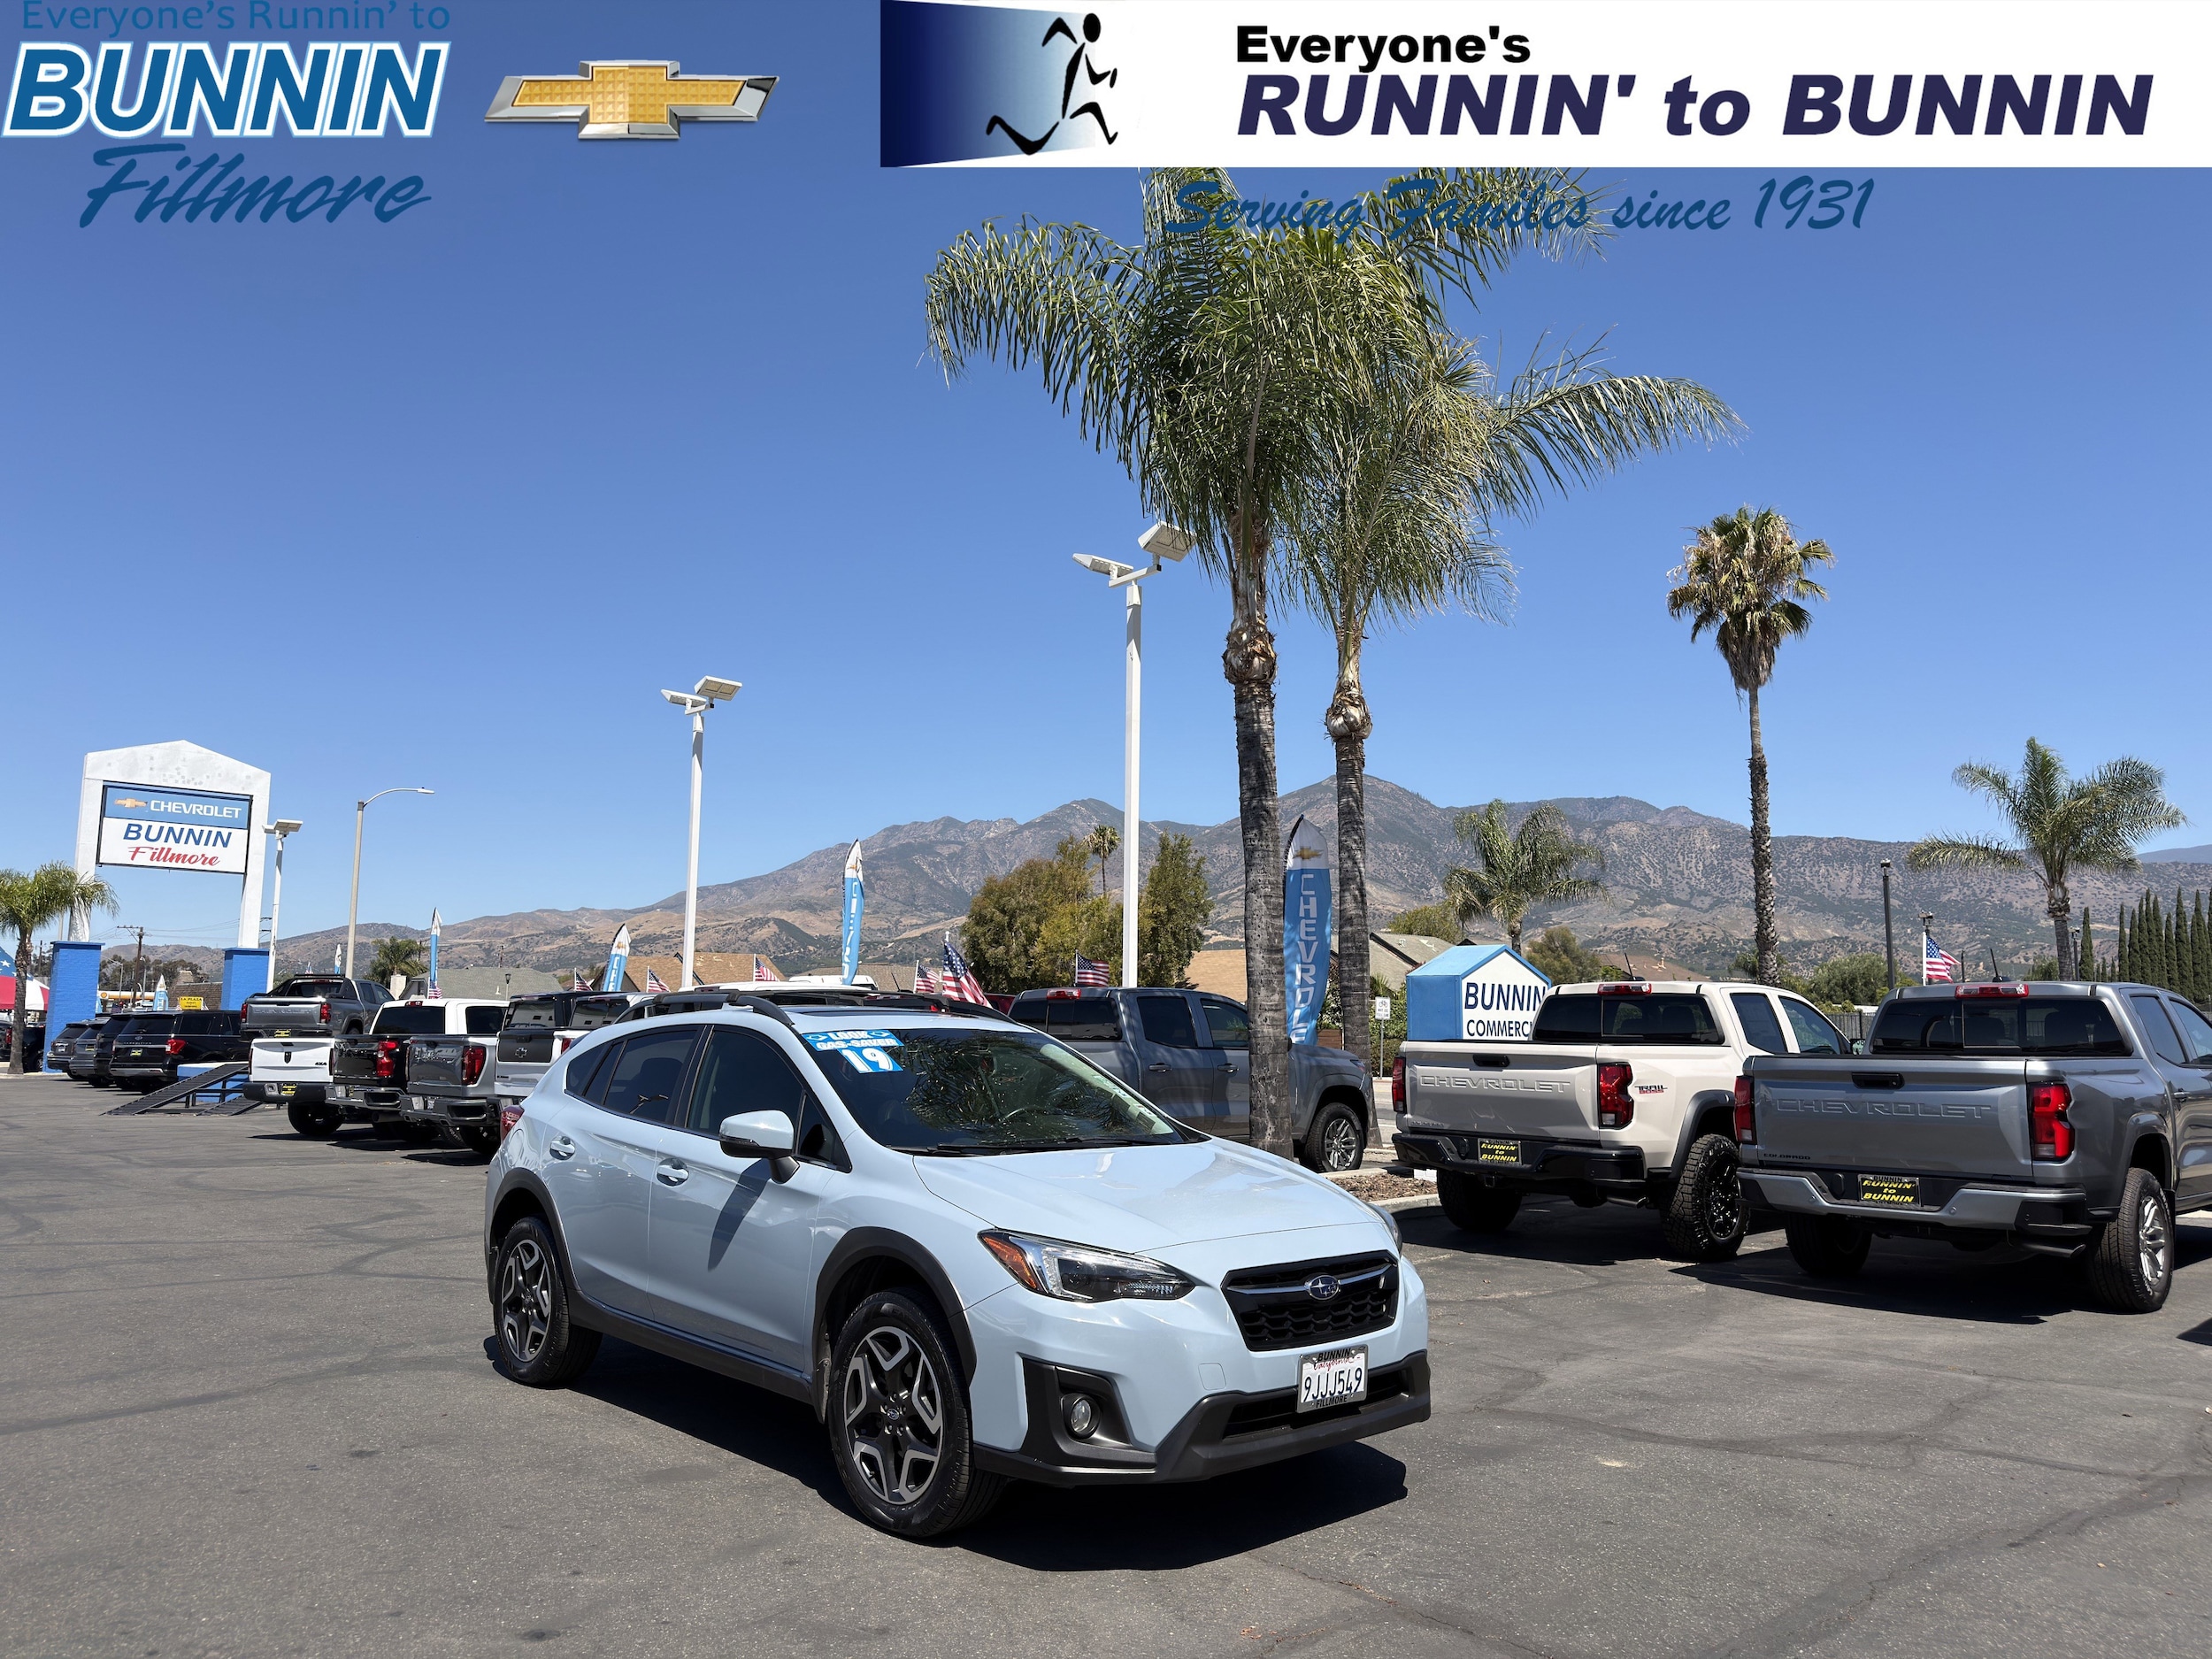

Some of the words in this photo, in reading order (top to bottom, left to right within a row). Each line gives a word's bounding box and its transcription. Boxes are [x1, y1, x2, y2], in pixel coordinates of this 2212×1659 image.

[150, 800, 242, 818] CHEVROLET
[123, 823, 232, 848] BUNNIN
[127, 846, 220, 866] Fillmore
[1464, 982, 1546, 1011] BUNNIN
[816, 1038, 899, 1050] GAS-SAVER
[827, 1030, 873, 1041] LOOK
[841, 1048, 894, 1073] 19
[1420, 1075, 1571, 1094] CHEVROLET
[1777, 1098, 1991, 1119] CHEVROLET
[1863, 1193, 1914, 1202] BUNNIN
[1317, 1348, 1351, 1362] BUNNIN
[1303, 1367, 1363, 1402] 9JJJ549
[1316, 1394, 1348, 1408] FILLMORE
